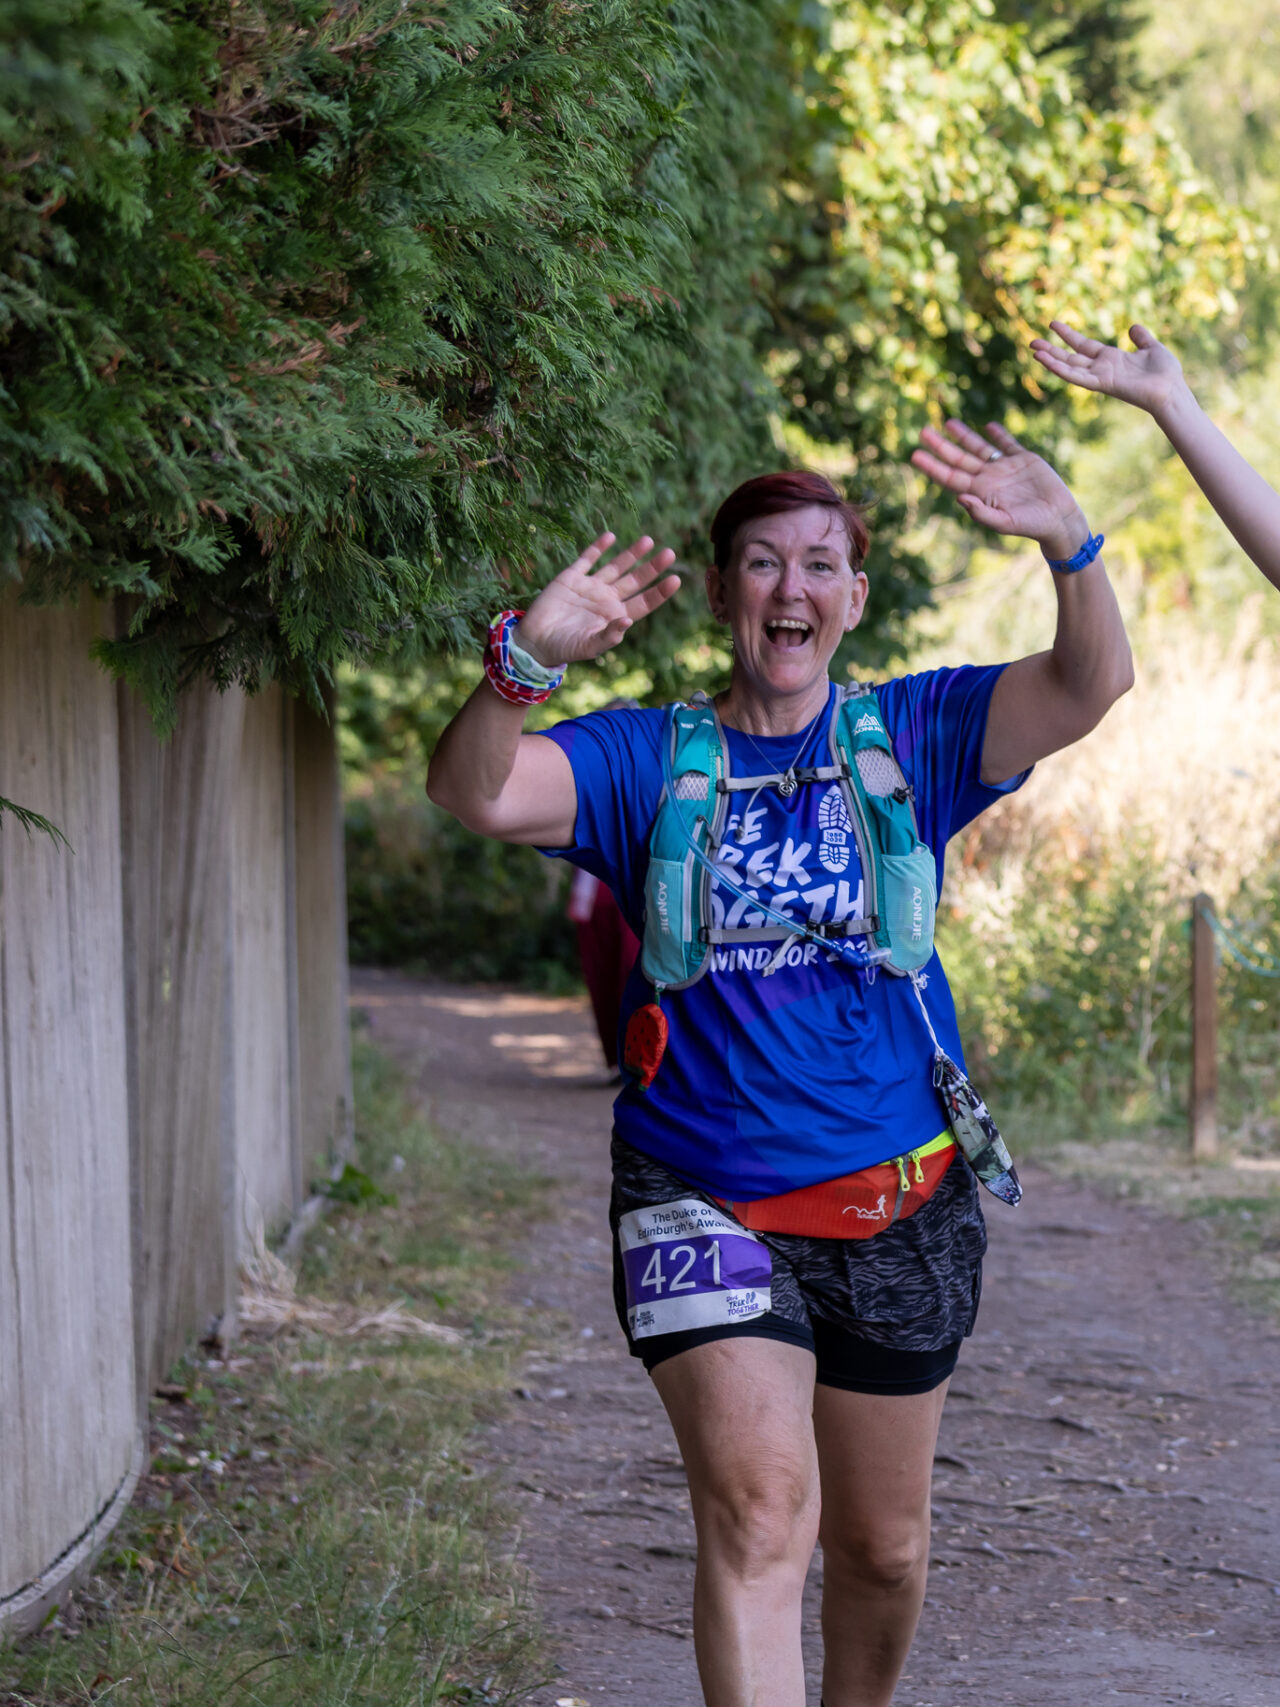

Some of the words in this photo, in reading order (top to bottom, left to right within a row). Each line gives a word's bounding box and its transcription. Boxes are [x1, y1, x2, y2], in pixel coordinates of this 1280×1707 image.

[711, 837, 812, 890] REK
[657, 880, 670, 936] AONIJIE
[912, 886, 922, 941] AONIJIE
[637, 1220, 694, 1240] Edinburgh's
[652, 1213, 671, 1223] The
[671, 1208, 698, 1220] Duke
[641, 1239, 721, 1295] 421
